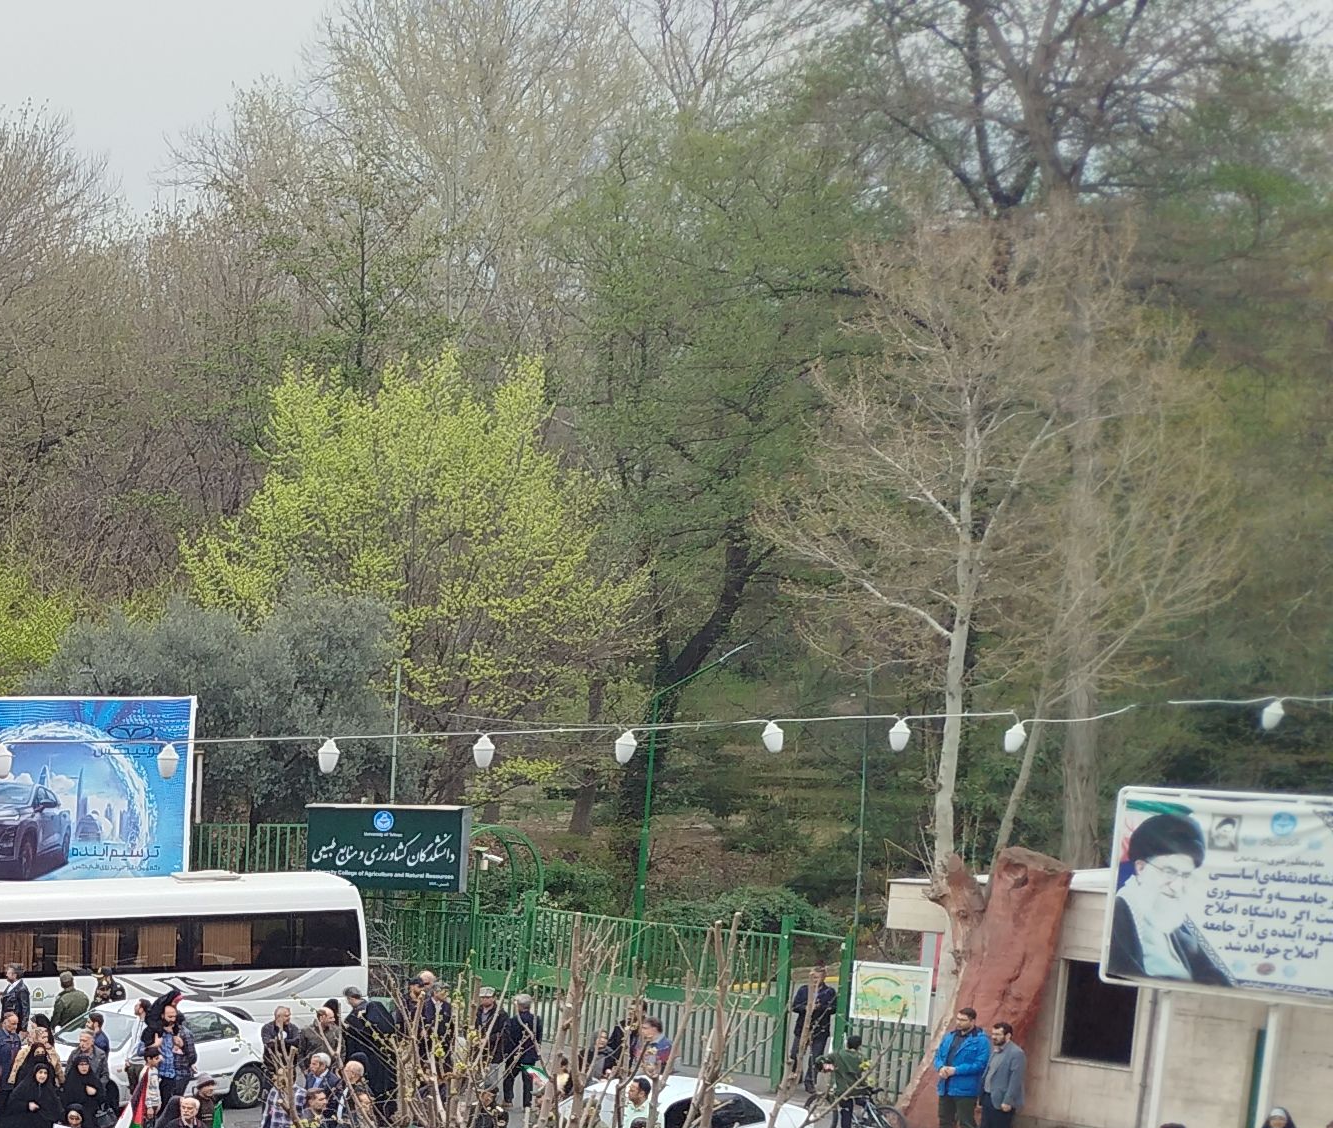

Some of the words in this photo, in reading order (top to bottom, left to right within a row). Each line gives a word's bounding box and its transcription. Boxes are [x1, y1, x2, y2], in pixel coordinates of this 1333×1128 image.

[71, 842, 109, 861] آینده
[109, 846, 160, 861] ترسیم
[311, 837, 336, 863] طبیعی
[335, 844, 357, 866] منابع
[364, 832, 422, 866] کشاورزی
[406, 832, 455, 866] دانشکدگان
[1208, 868, 1258, 881] اساسی
[1207, 888, 1266, 900] کشوری
[1267, 892, 1273, 904] و
[1275, 891, 1327, 907] جامعه
[1204, 901, 1238, 916] اصلاح
[1241, 905, 1286, 919] دانشگاه
[1290, 910, 1310, 924] اگر
[1203, 920, 1235, 933] جامعه
[1238, 920, 1254, 937] آن
[1244, 942, 1280, 958] خواهد
[1283, 946, 1319, 960] اصلاح
